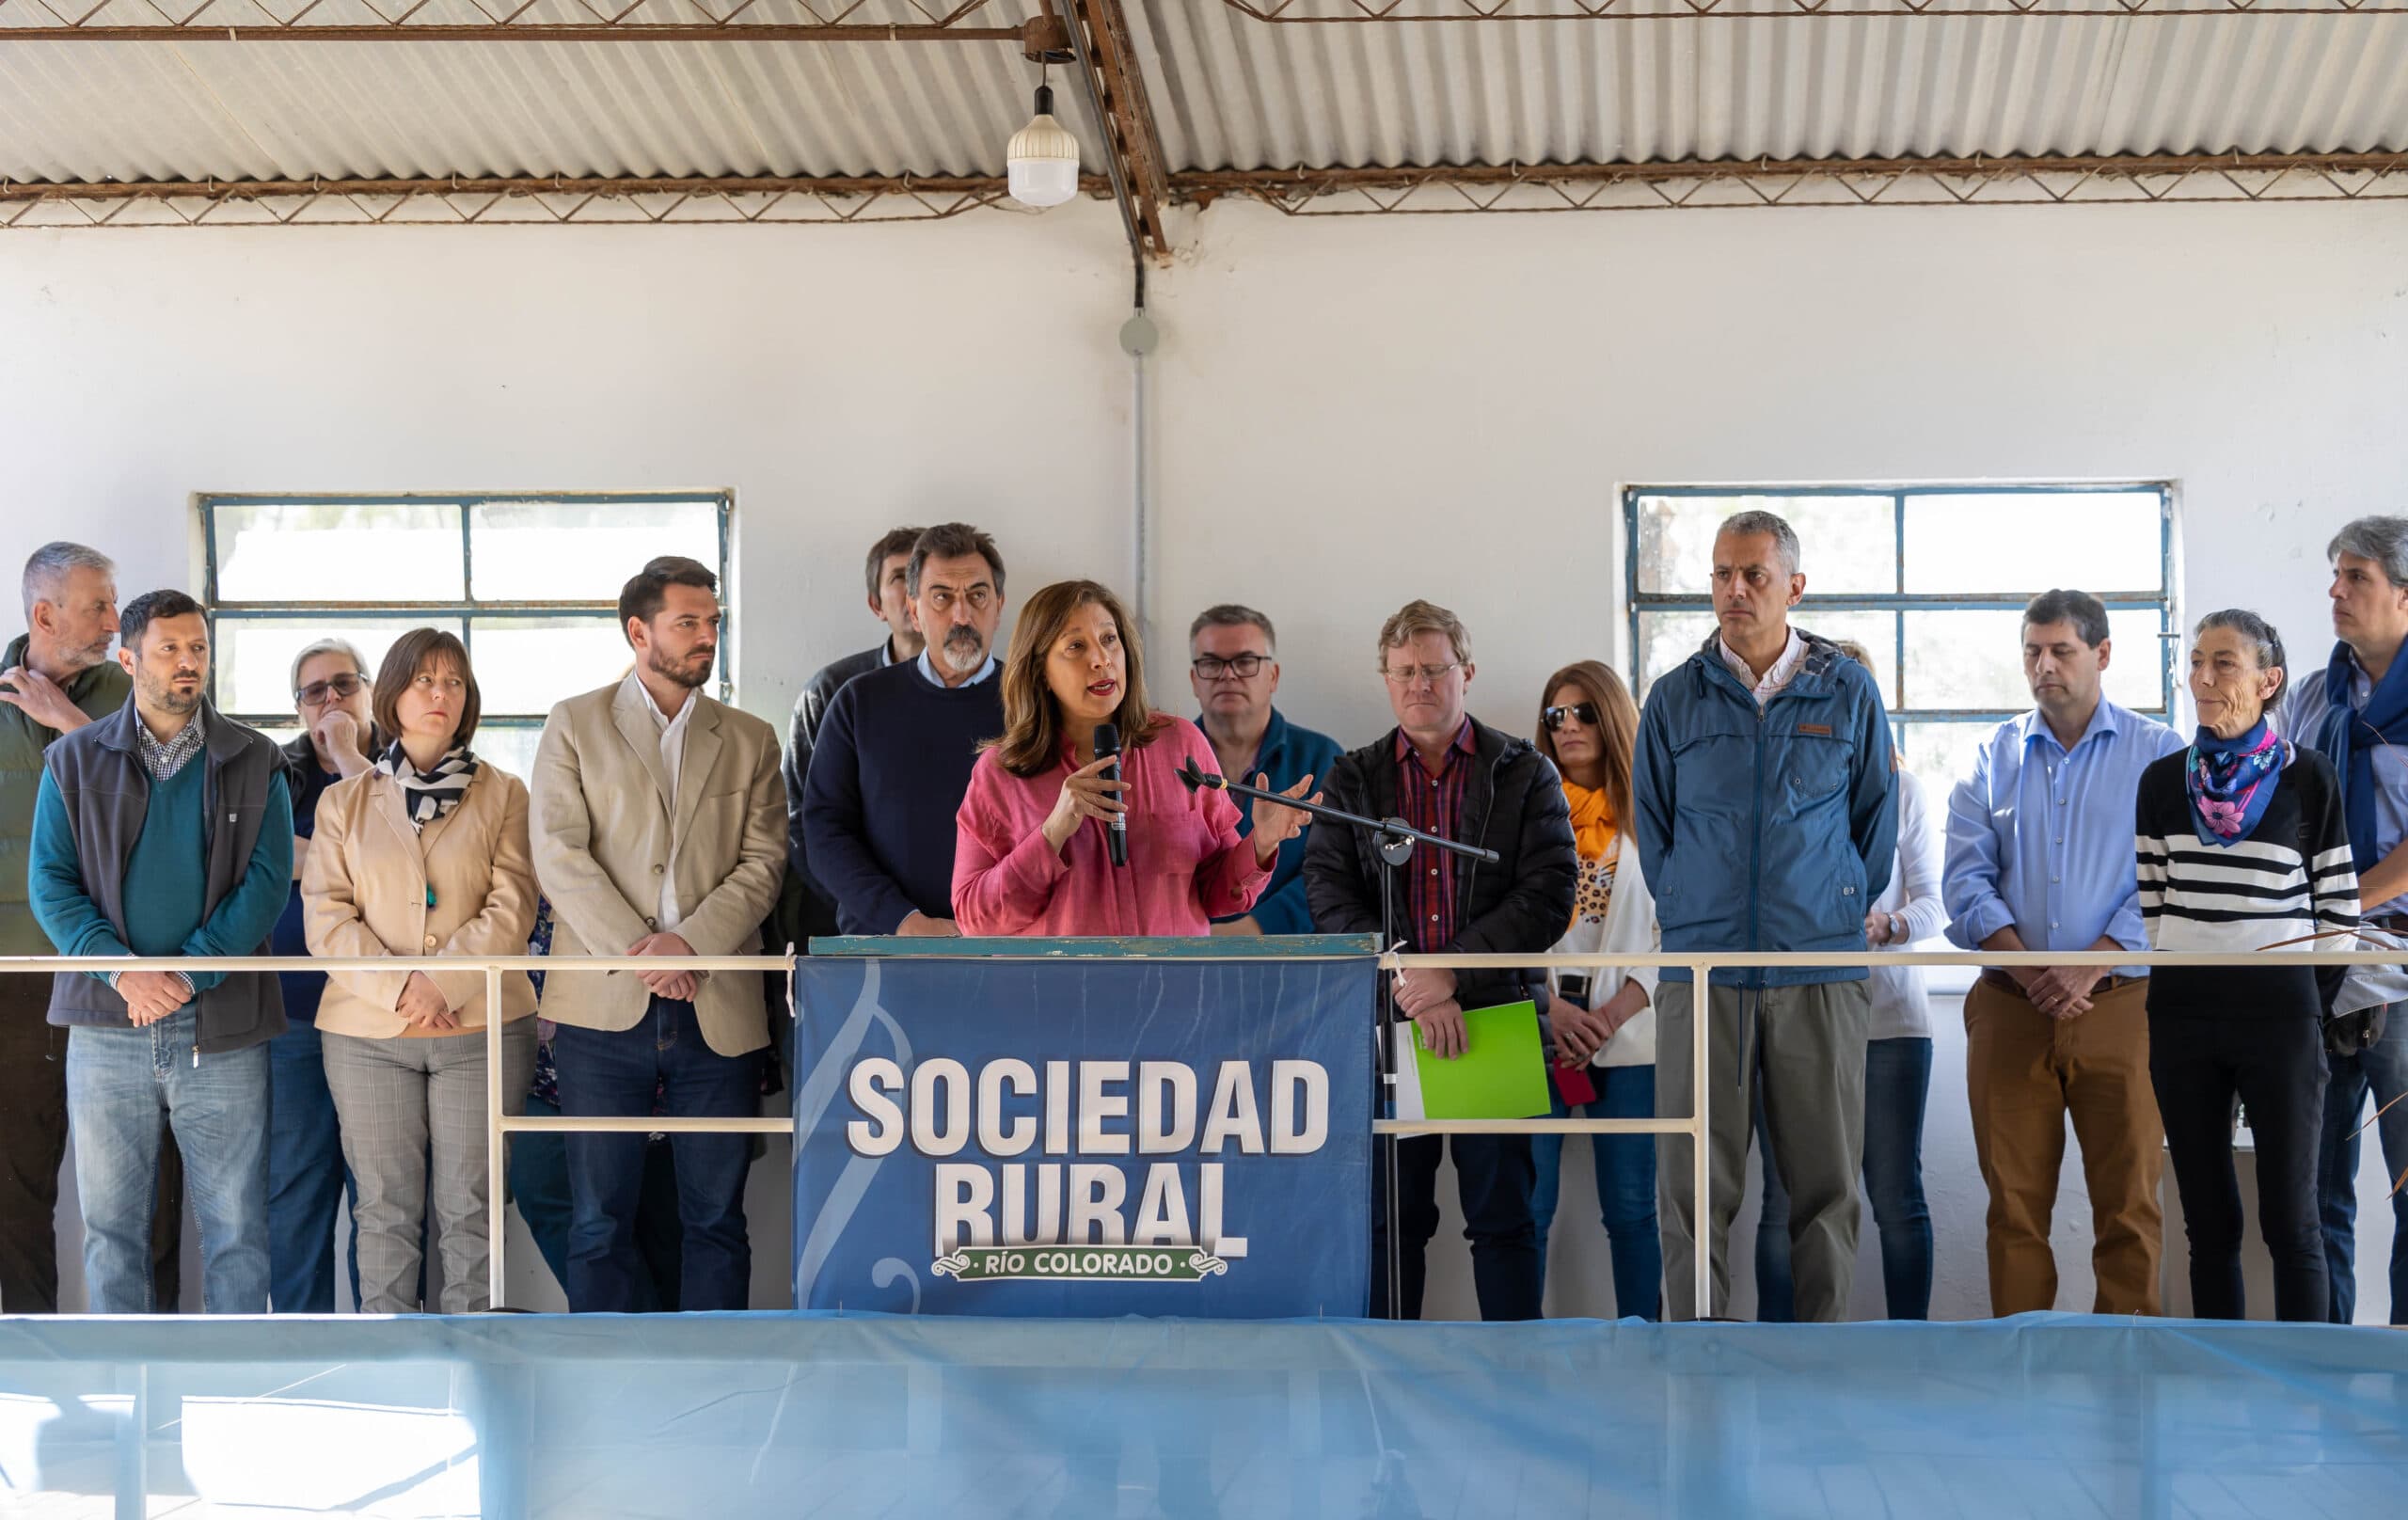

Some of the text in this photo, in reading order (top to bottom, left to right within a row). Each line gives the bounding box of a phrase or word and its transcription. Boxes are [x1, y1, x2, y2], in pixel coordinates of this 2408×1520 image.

[848, 1057, 1329, 1156] SOCIEDAD
[935, 1163, 1248, 1259] RURAL
[985, 1250, 1173, 1275] RÍO COLORADO
